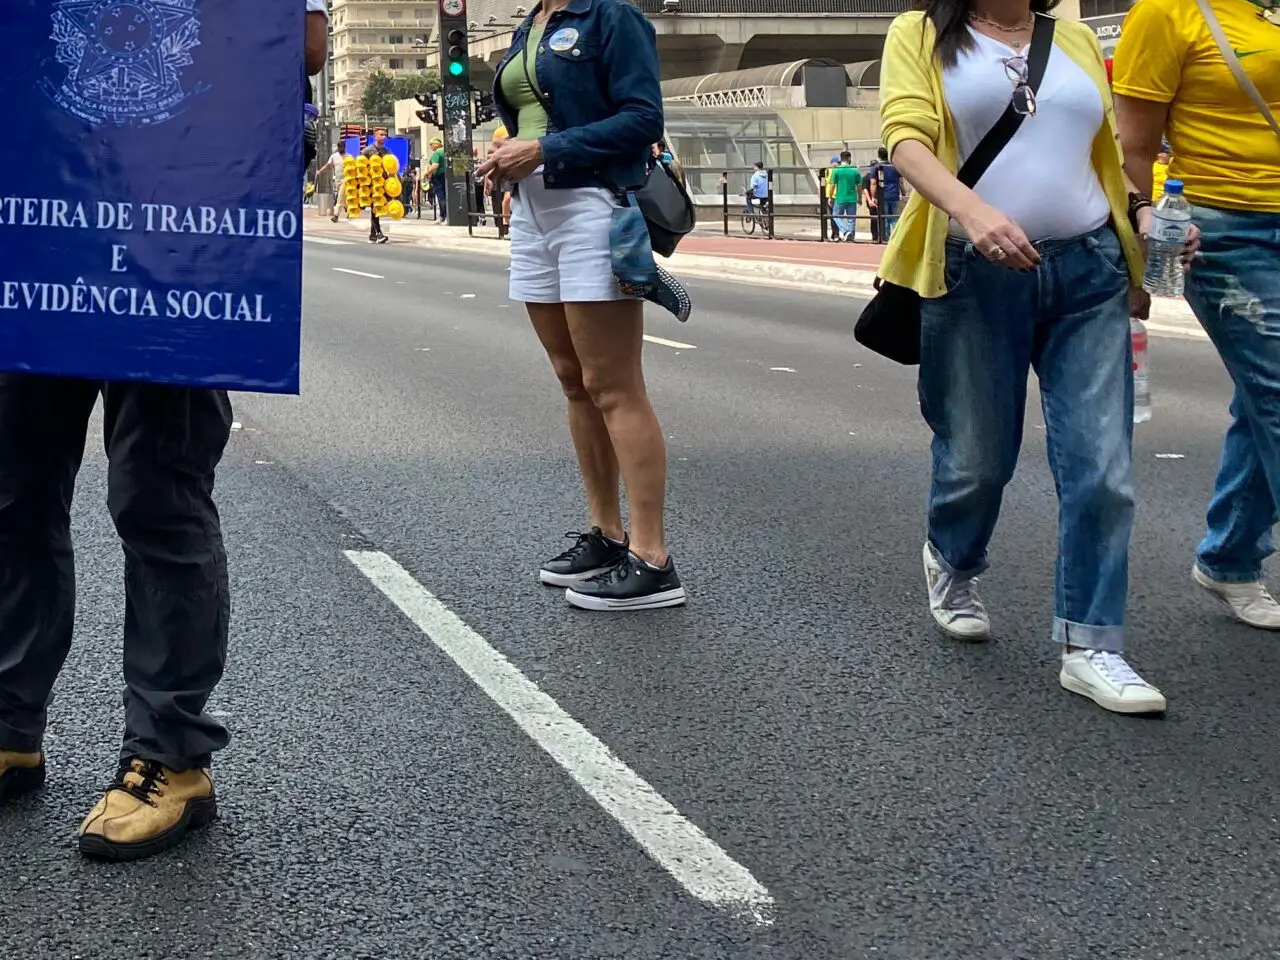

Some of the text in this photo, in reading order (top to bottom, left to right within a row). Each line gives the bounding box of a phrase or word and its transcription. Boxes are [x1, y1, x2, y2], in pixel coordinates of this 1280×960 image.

[96, 201, 133, 231] DE
[141, 203, 297, 238] TRABALHO
[110, 244, 127, 272] E
[166, 289, 272, 323] SOCIAL
